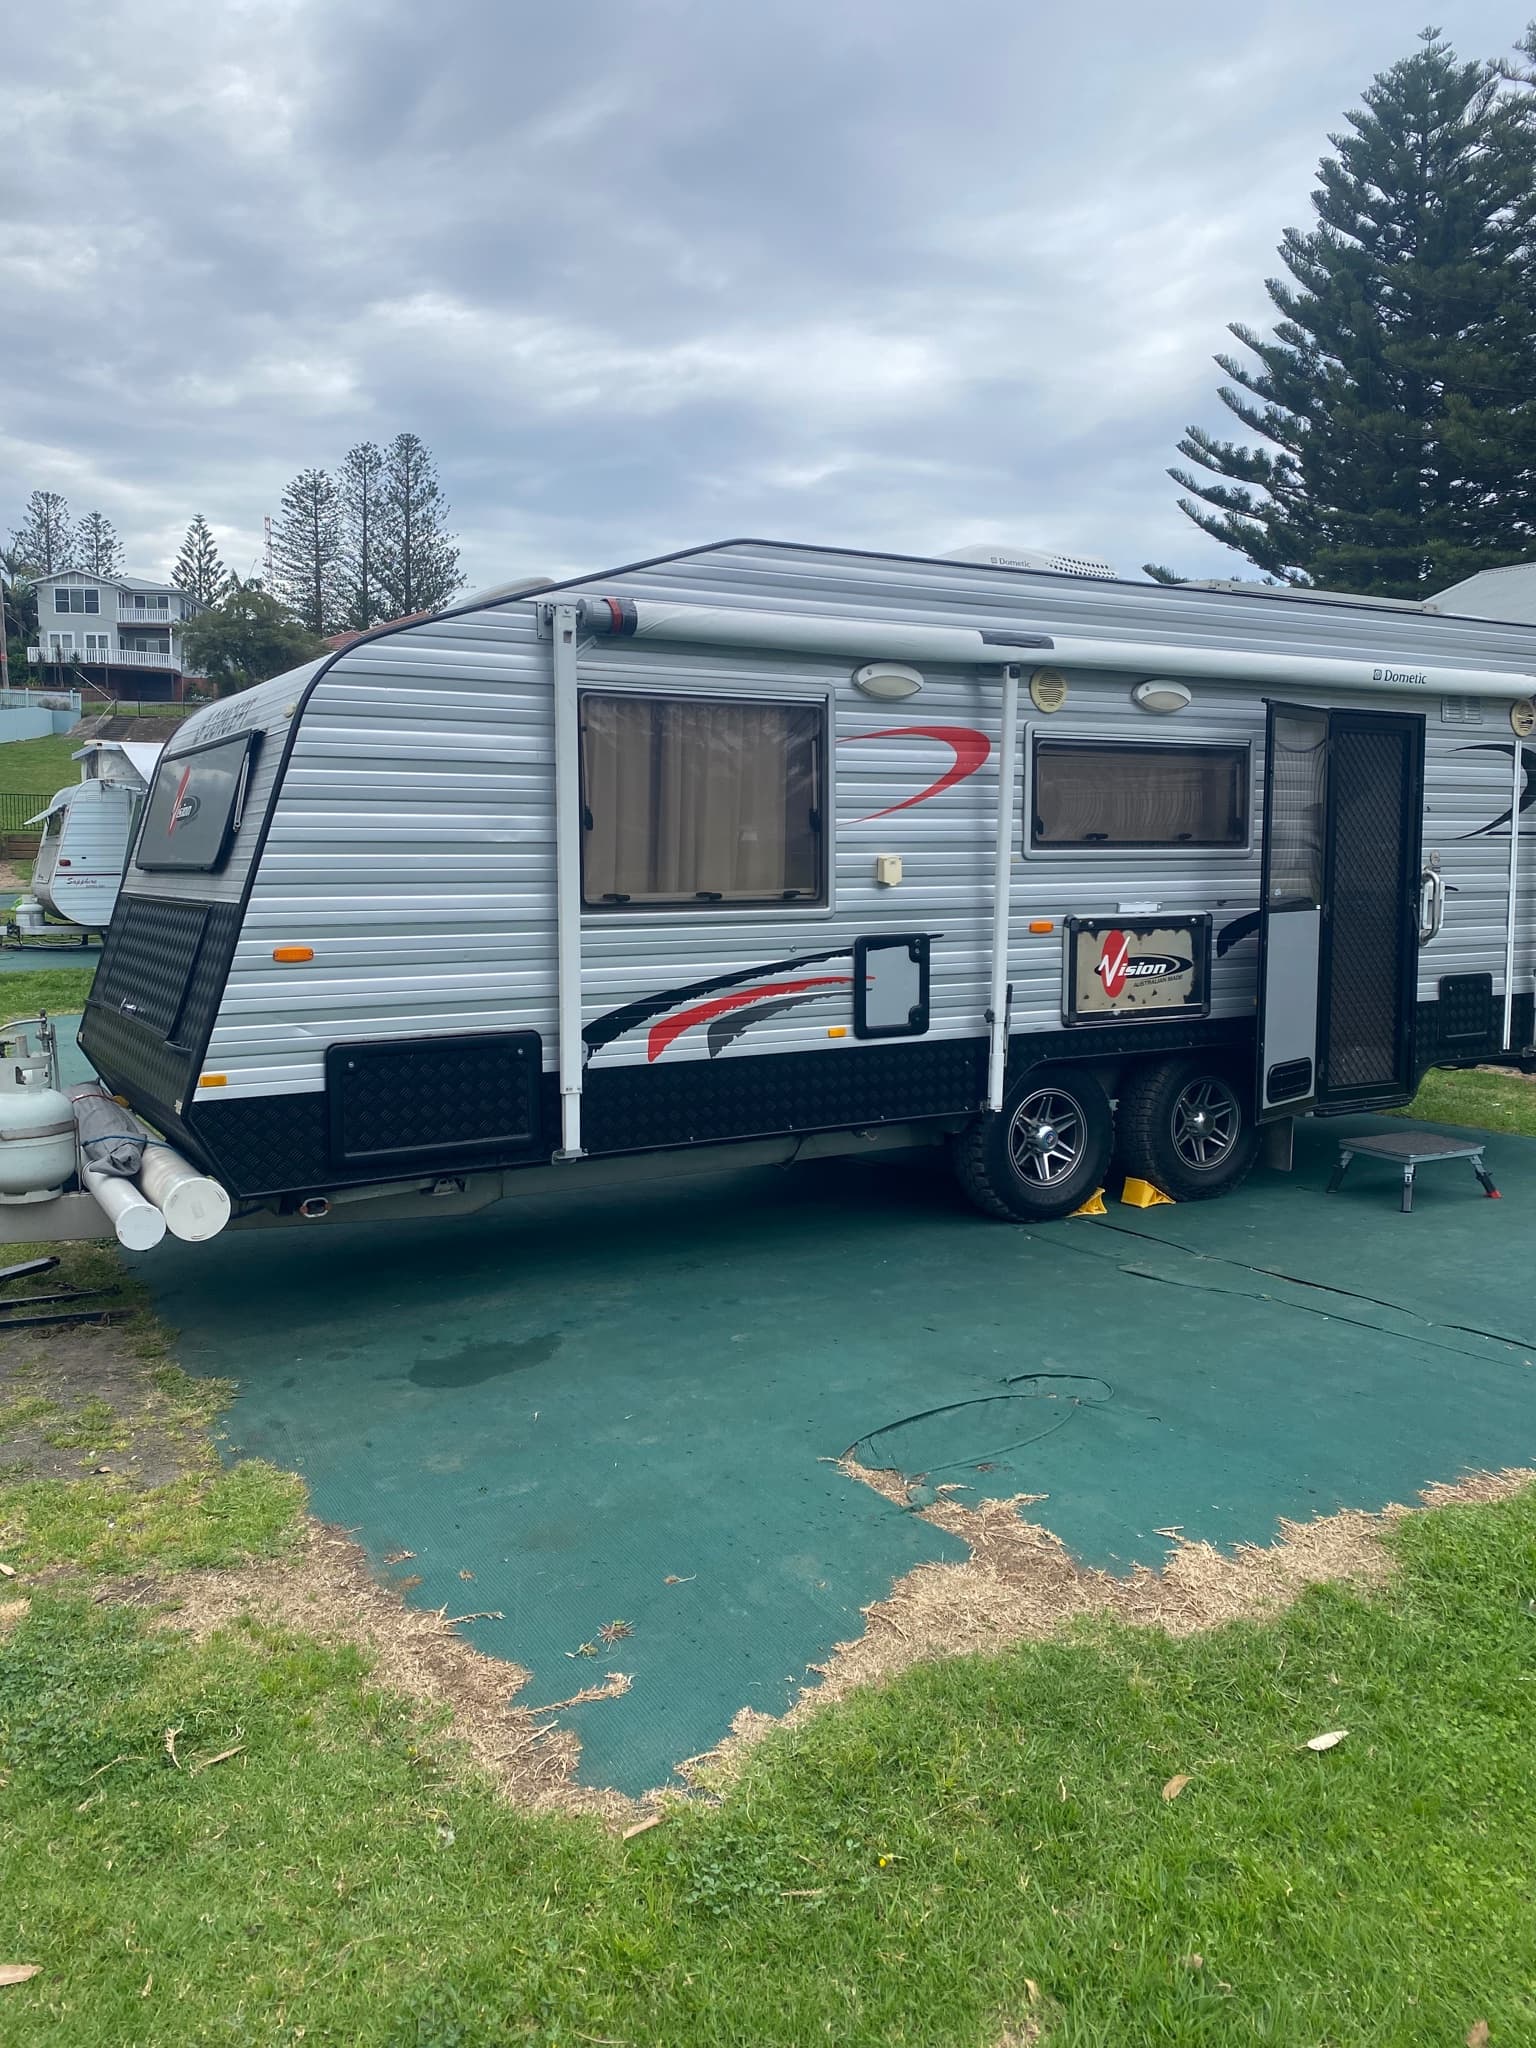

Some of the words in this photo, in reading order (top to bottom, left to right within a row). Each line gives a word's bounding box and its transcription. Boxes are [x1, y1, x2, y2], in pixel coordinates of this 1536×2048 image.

[999, 557, 1031, 568] Dometic
[1384, 669, 1427, 684] Dometic
[1098, 936, 1167, 988] Vision
[1133, 976, 1167, 987] AUSTRALIAN
